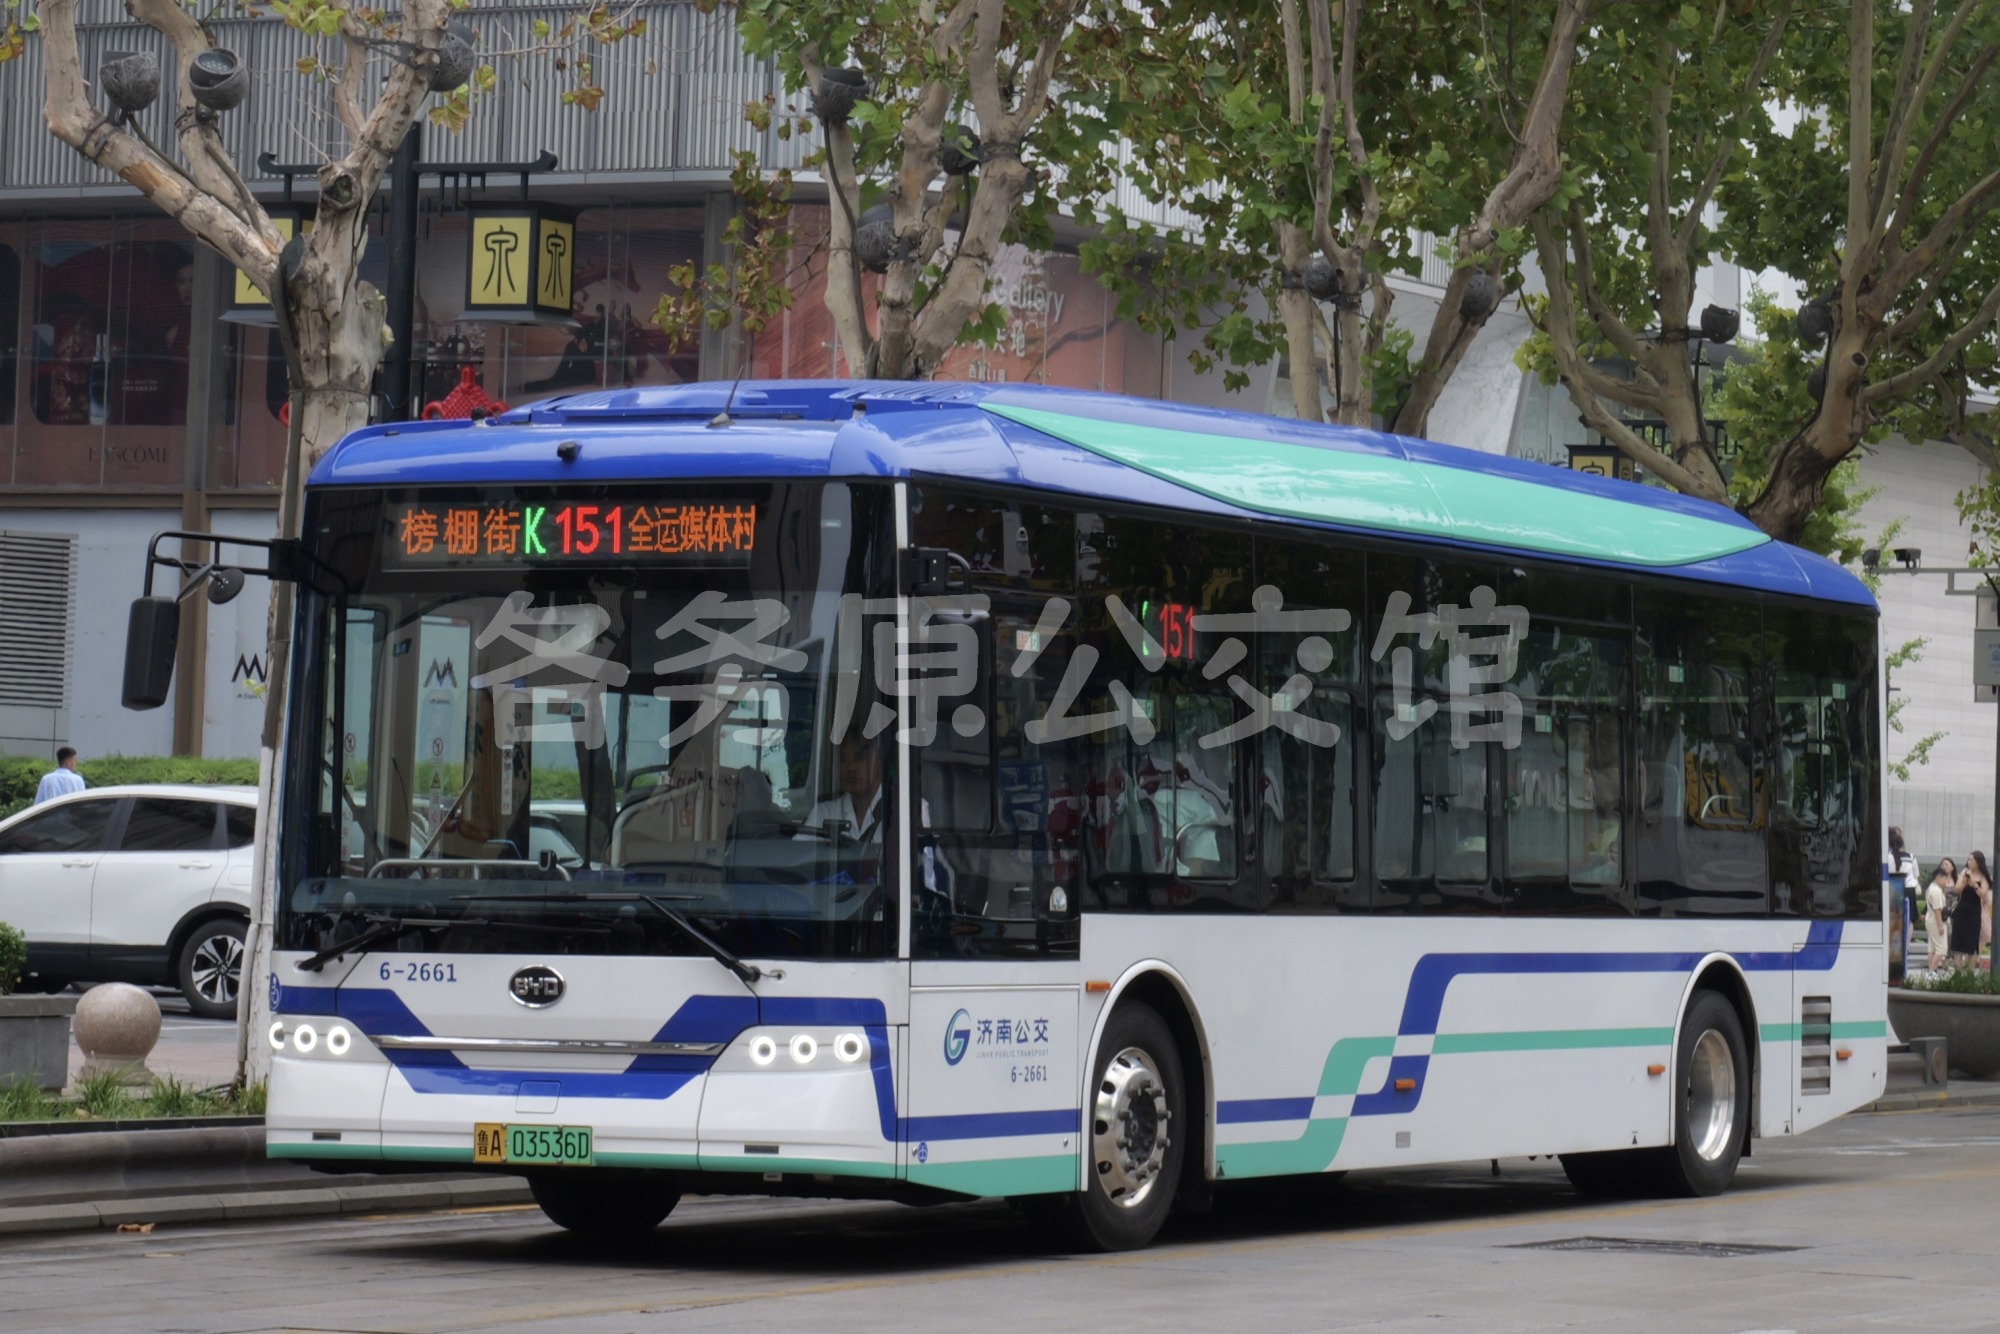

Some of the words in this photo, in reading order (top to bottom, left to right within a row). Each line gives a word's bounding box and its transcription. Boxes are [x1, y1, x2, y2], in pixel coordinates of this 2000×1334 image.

[401, 508, 520, 555] 榜棚街
[628, 505, 755, 552] 全运媒体村
[380, 962, 457, 982] 6-2661
[514, 977, 559, 996] BYD
[977, 1017, 1049, 1044] 济南公交
[995, 1050, 1015, 1058] PUBLIC
[1017, 1049, 1049, 1057] TRANSPORT
[1011, 1065, 1047, 1083] 6-2661
